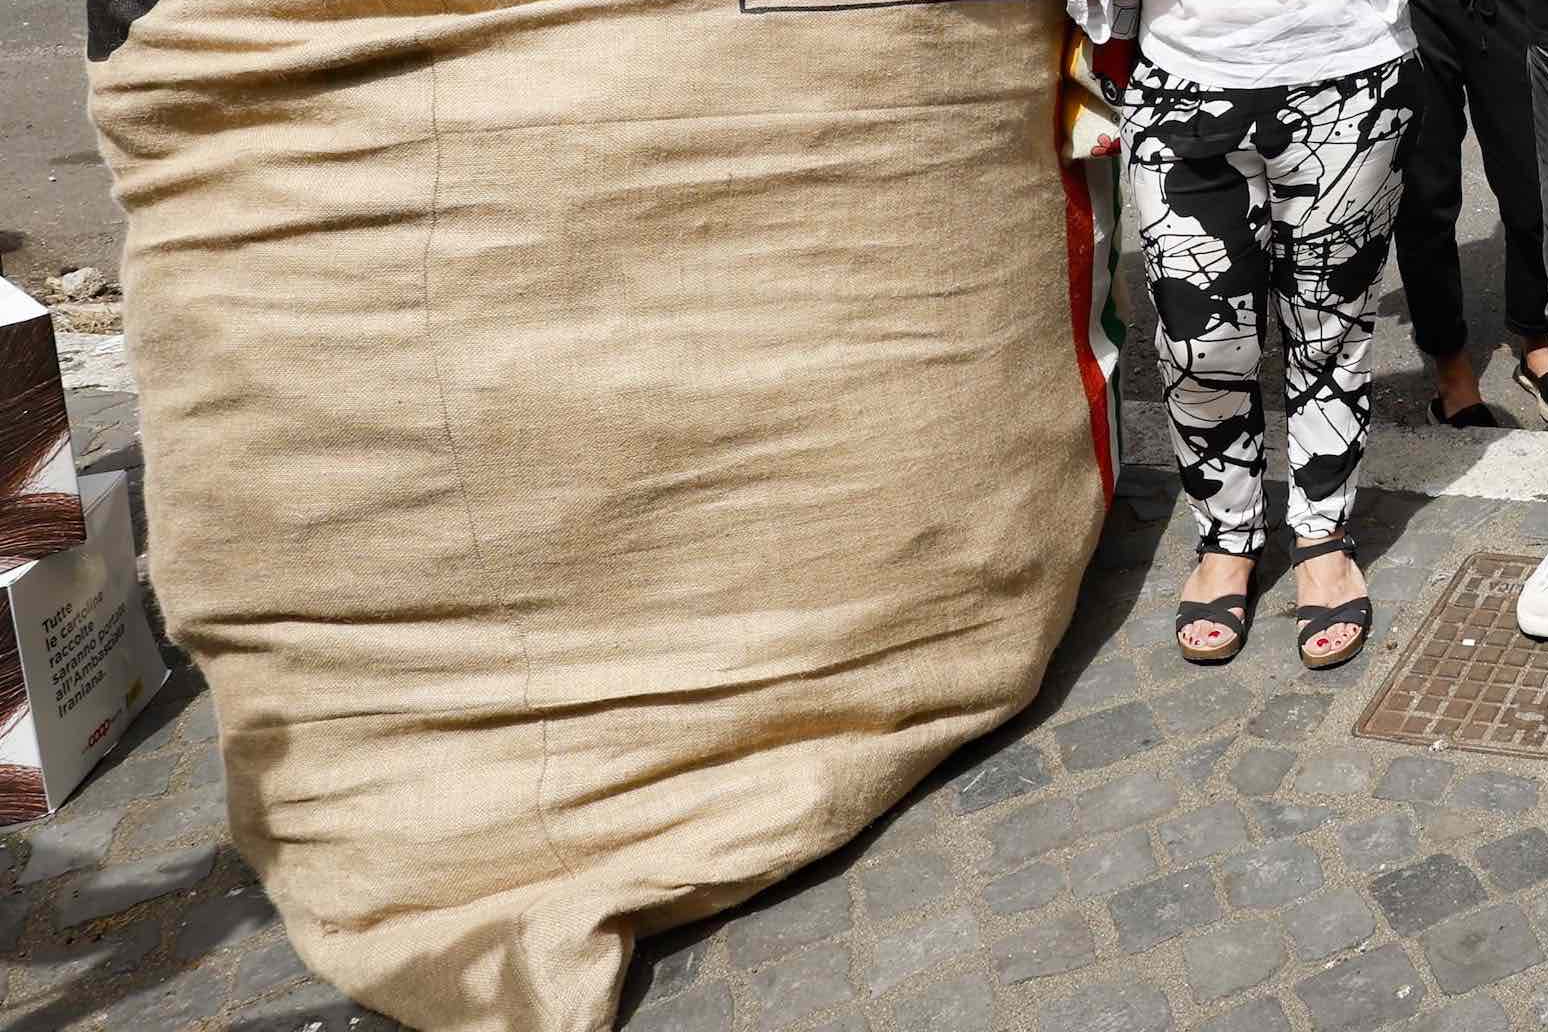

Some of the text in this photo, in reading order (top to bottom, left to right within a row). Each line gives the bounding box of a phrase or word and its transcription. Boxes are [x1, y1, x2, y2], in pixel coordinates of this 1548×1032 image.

[42, 603, 73, 634] Tutte
[46, 637, 58, 653] le
[50, 621, 94, 668] raccolte
[52, 639, 97, 686] saranno
